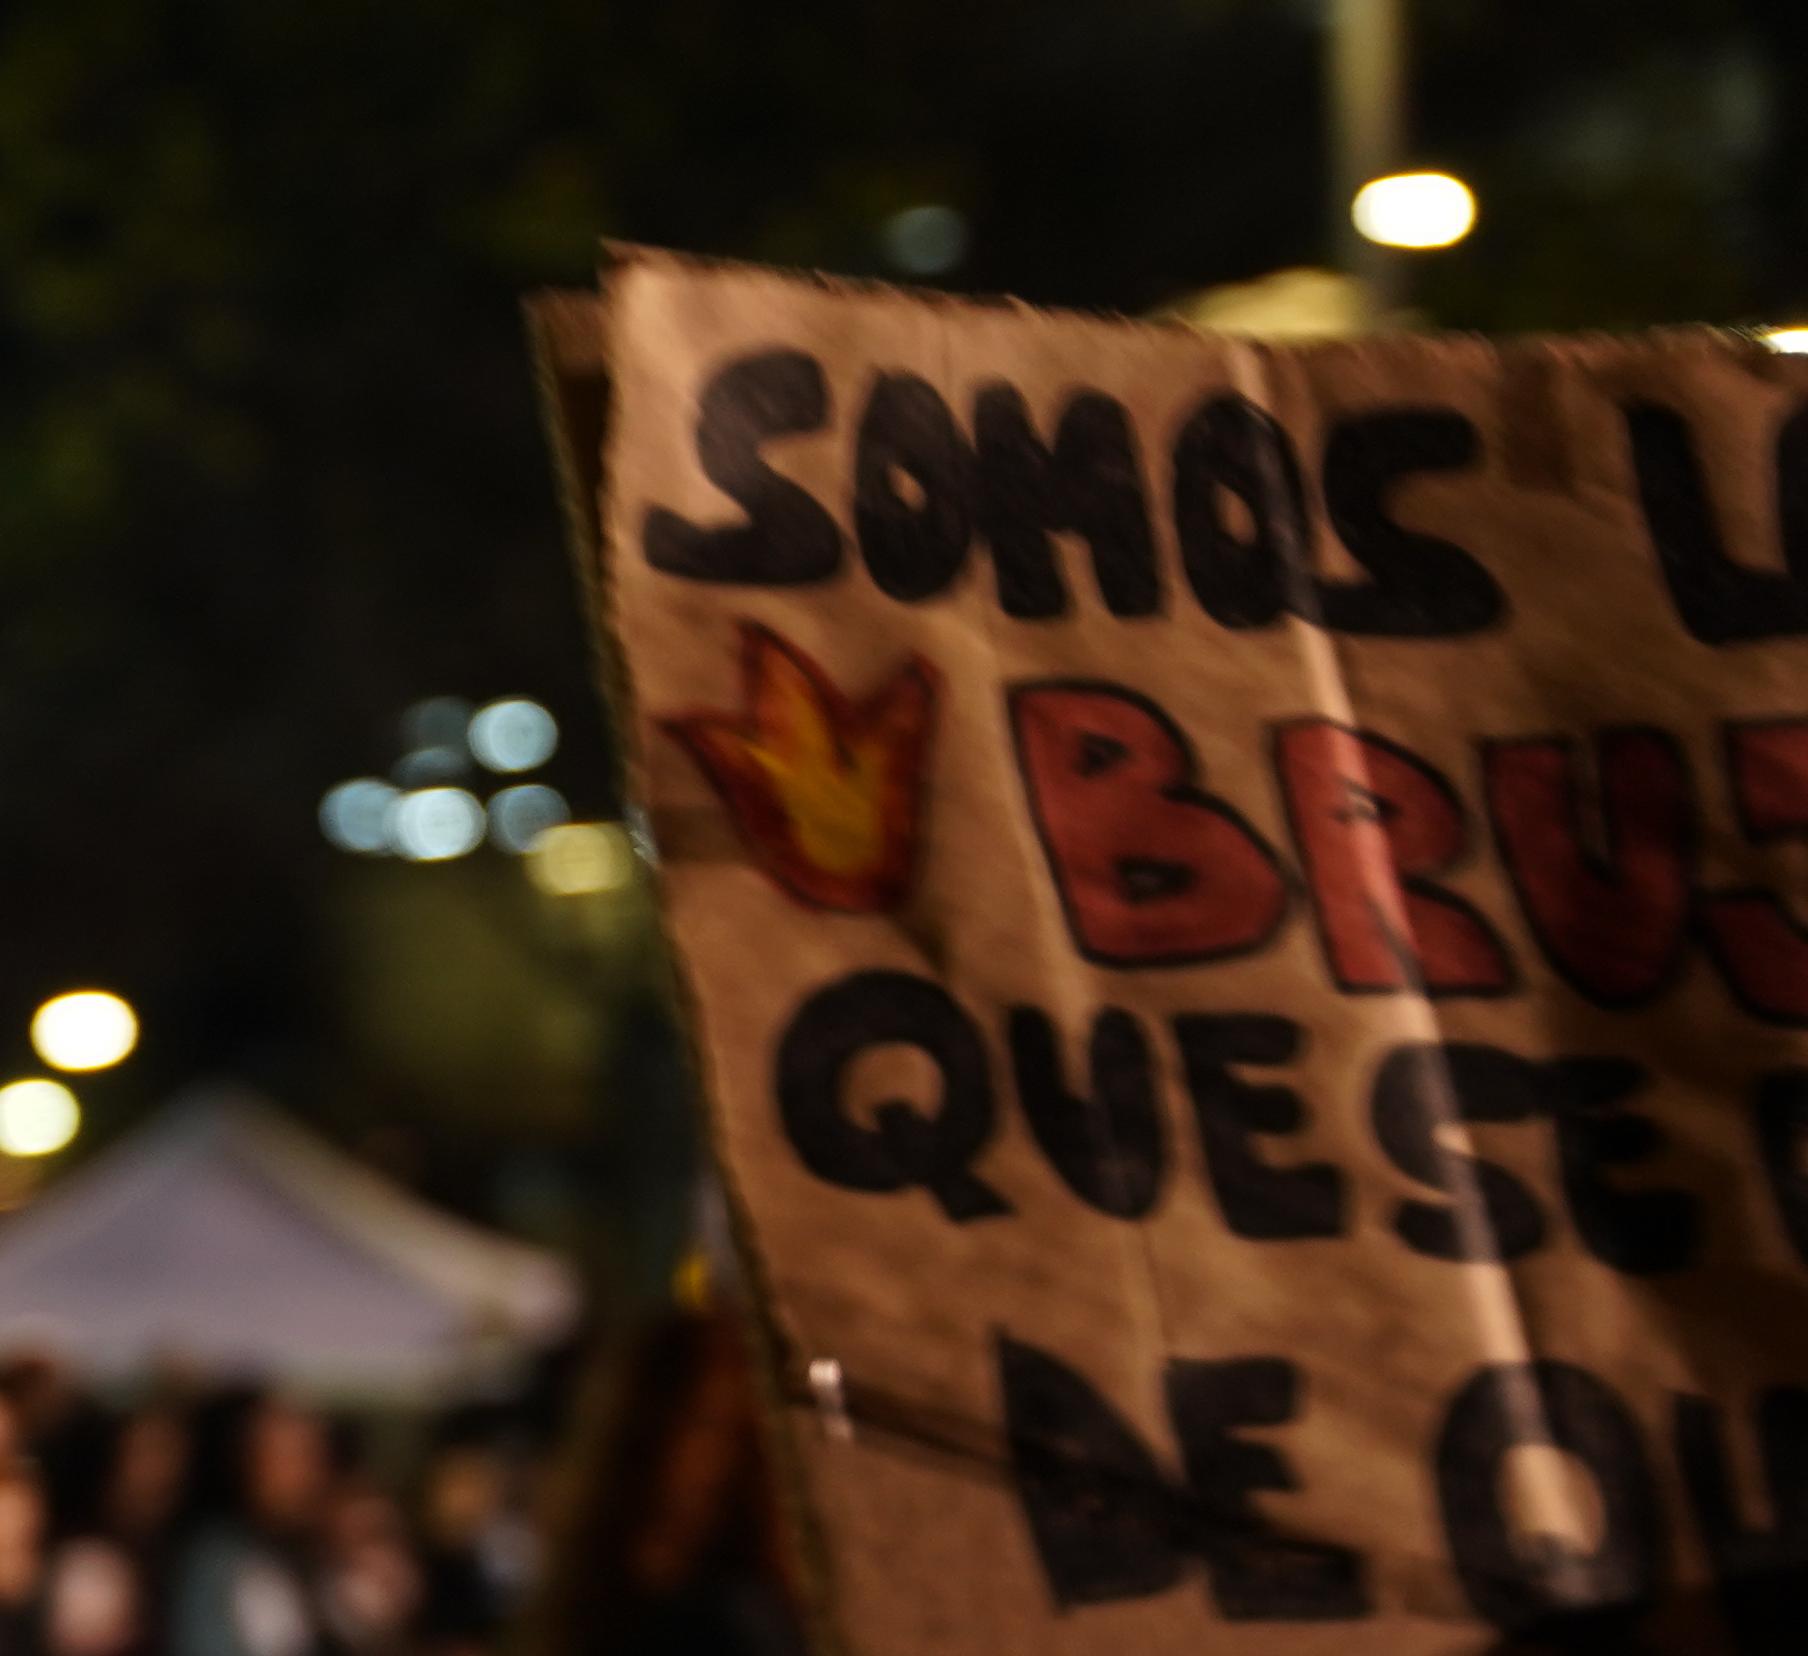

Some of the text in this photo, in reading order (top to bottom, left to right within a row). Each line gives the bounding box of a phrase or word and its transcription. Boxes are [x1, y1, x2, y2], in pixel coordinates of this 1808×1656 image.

[639, 346, 1808, 646] SOMOS L
[994, 1330, 1375, 1621] DE
